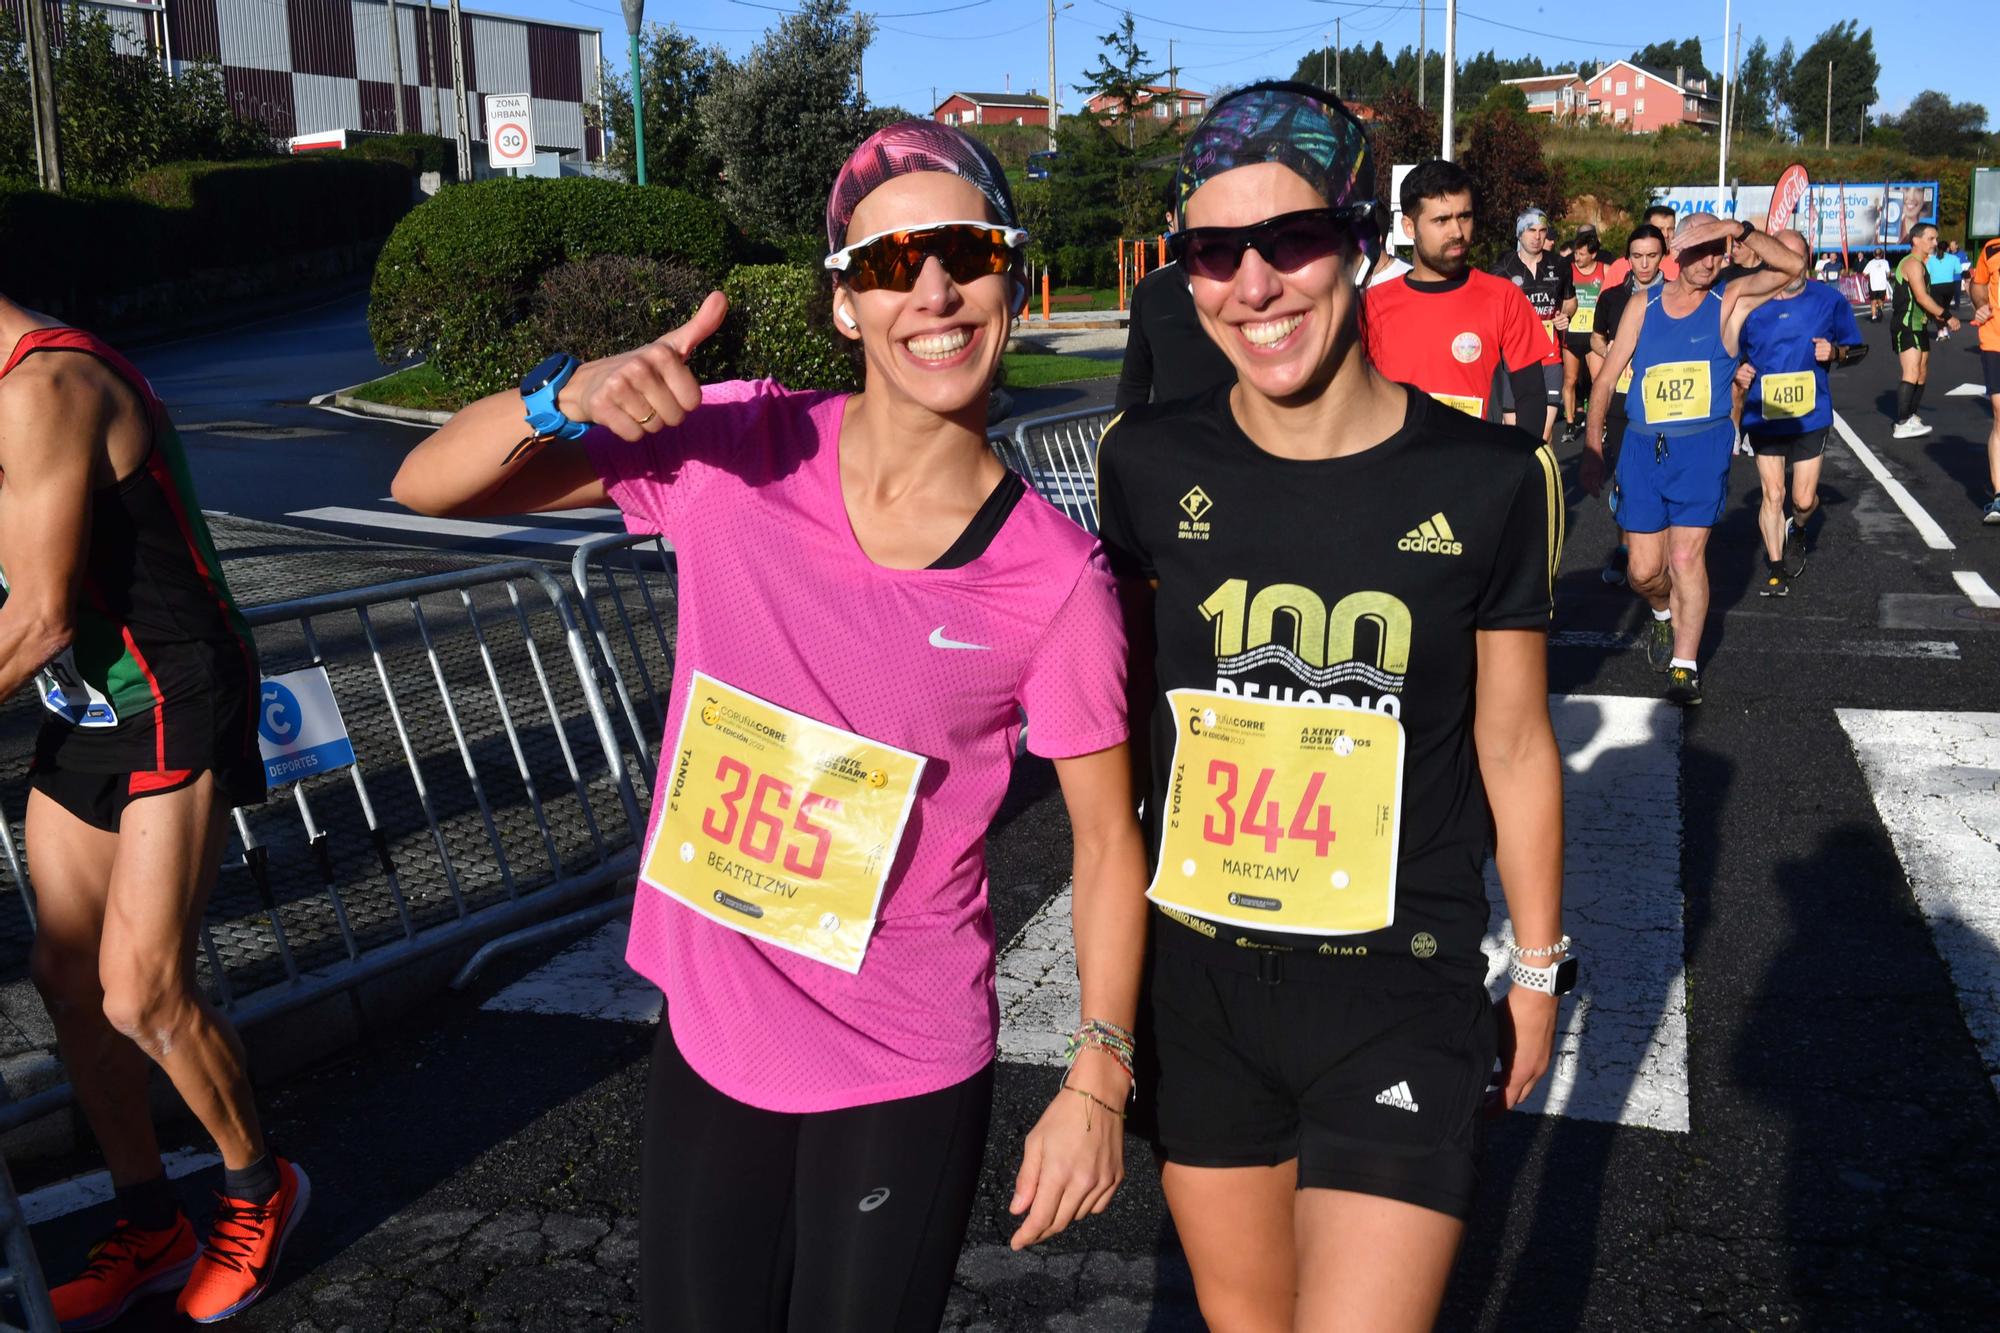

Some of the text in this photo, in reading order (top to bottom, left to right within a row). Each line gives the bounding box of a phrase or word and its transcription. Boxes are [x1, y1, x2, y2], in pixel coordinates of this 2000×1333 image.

[496, 99, 520, 108] ZONA
[491, 110, 527, 119] URBANA
[502, 135, 520, 147] 30
[1667, 200, 1738, 214] DAIKN
[1656, 379, 1695, 402] 482
[1773, 385, 1804, 404] 480
[1397, 536, 1463, 556] adidas
[1198, 578, 1412, 674] 100
[1301, 727, 1346, 737] A XENTE
[1301, 736, 1323, 745] DOS
[269, 754, 319, 778] DEPORTES
[671, 749, 692, 812] TANDA 2
[1171, 764, 1185, 829] TANDA 2
[702, 755, 840, 880] 365
[1203, 759, 1337, 857] 344
[707, 851, 799, 899] BEATRIZMV
[1222, 859, 1300, 883] MARTAMV
[1375, 1093, 1419, 1113] adidas
